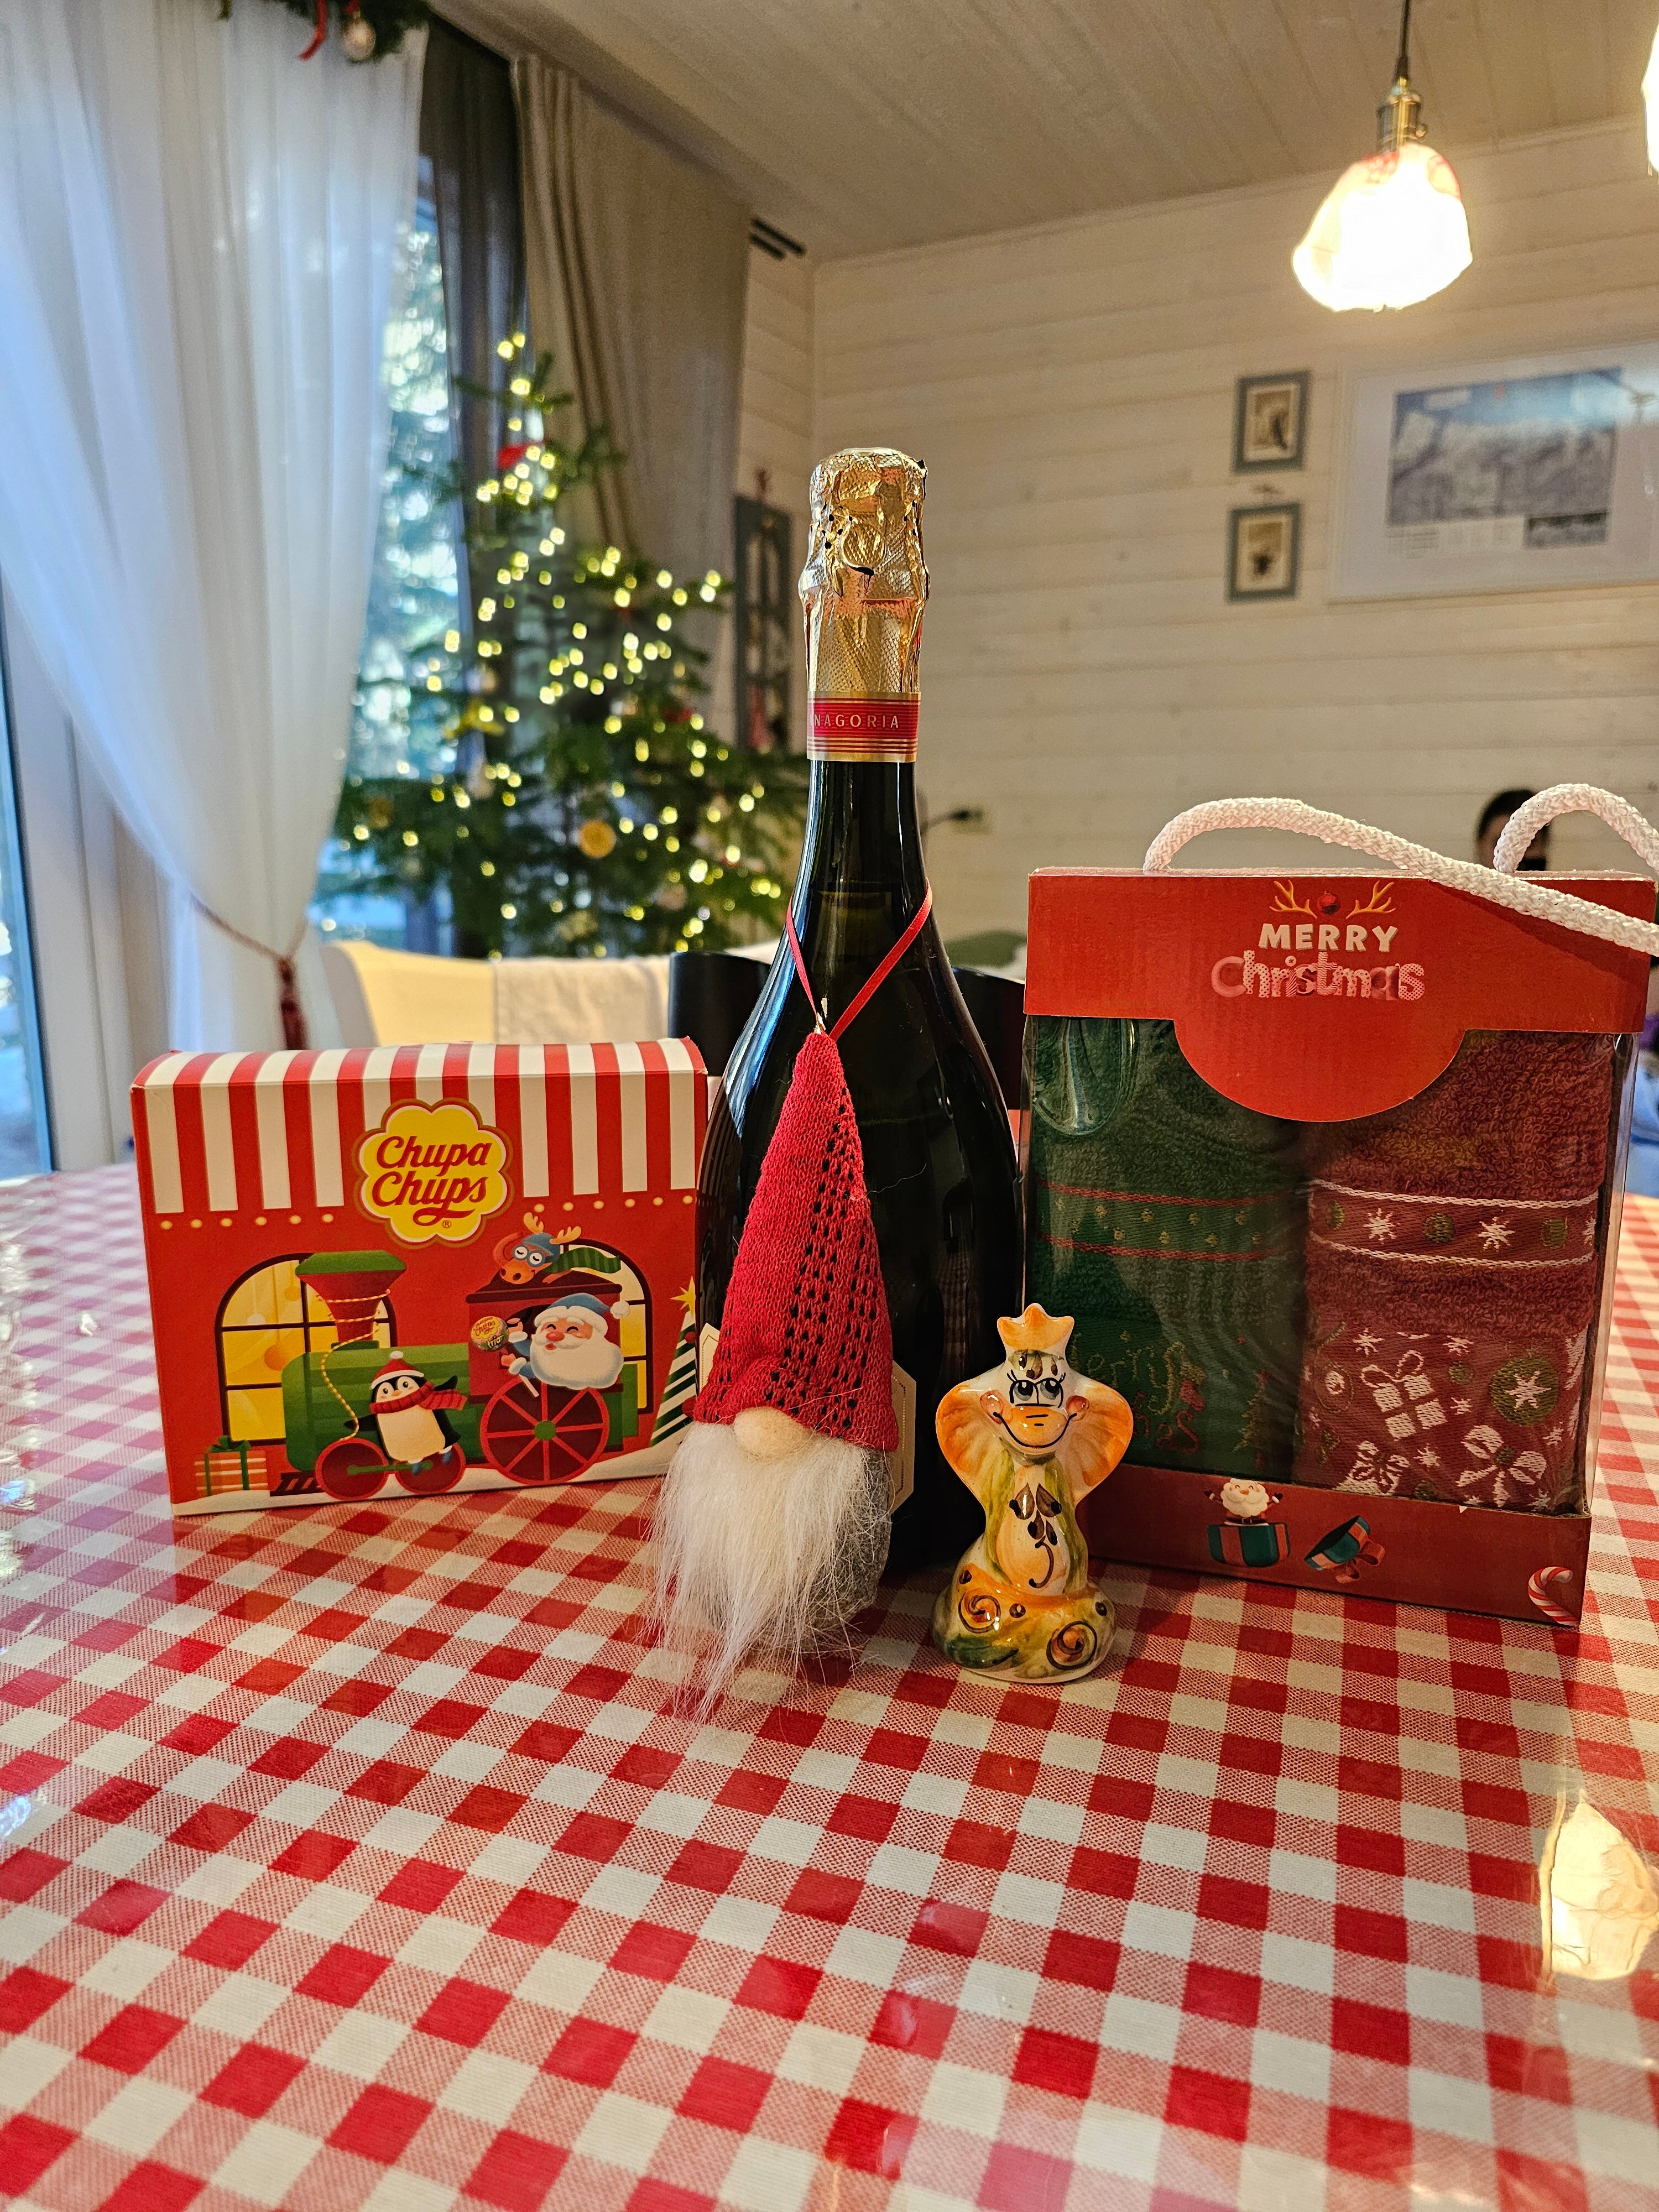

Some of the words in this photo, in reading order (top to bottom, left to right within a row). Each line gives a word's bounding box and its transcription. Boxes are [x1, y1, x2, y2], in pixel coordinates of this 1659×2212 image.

[1258, 923, 1398, 953] MERRY
[1211, 950, 1426, 1001] Christmas
[376, 1135, 493, 1177] Chupa
[372, 1170, 489, 1227] Chups
